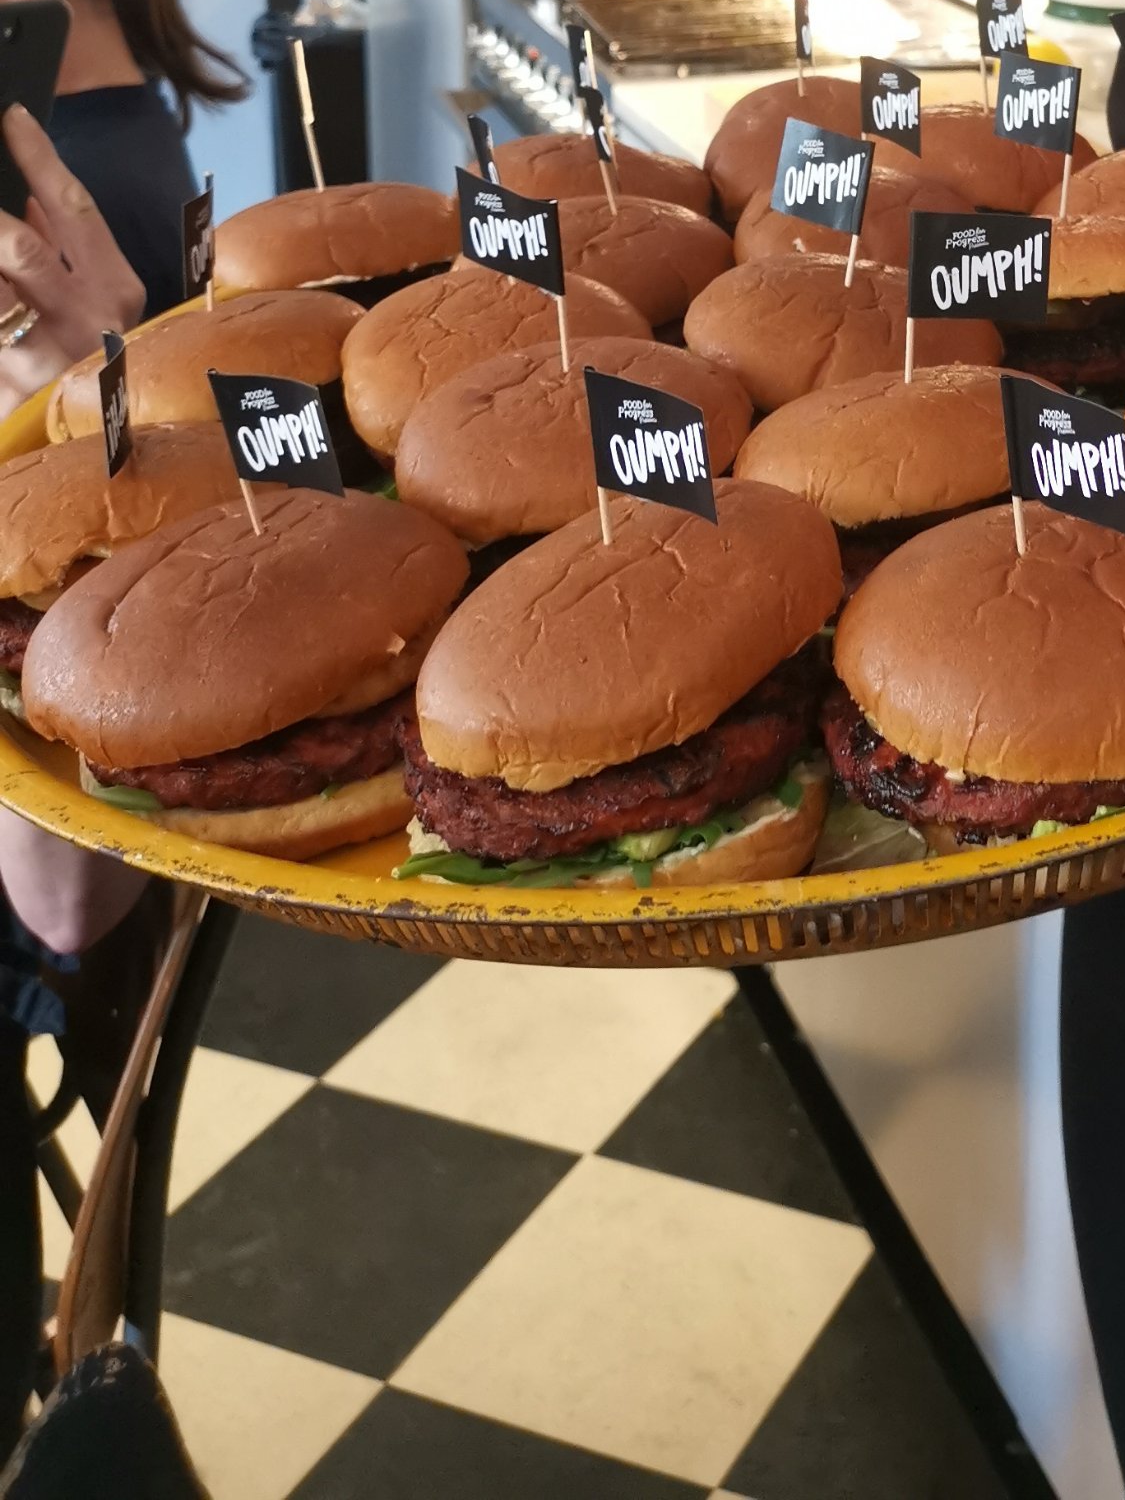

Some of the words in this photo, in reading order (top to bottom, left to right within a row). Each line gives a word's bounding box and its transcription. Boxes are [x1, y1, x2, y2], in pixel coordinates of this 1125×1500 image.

[872, 87, 919, 131] OUMPH!
[1003, 77, 1072, 132] OUMPH!
[784, 153, 861, 207] OUMPH!
[469, 213, 549, 261] OUMPH!
[945, 235, 986, 249] Progress
[952, 229, 974, 241] FOOD
[931, 233, 1043, 311] OUMPH!
[618, 406, 654, 421] Progress
[622, 400, 643, 410] FOOD
[1042, 408, 1061, 419] FOOD
[237, 400, 328, 473] OUMPH!
[609, 422, 707, 486] OUMPH!
